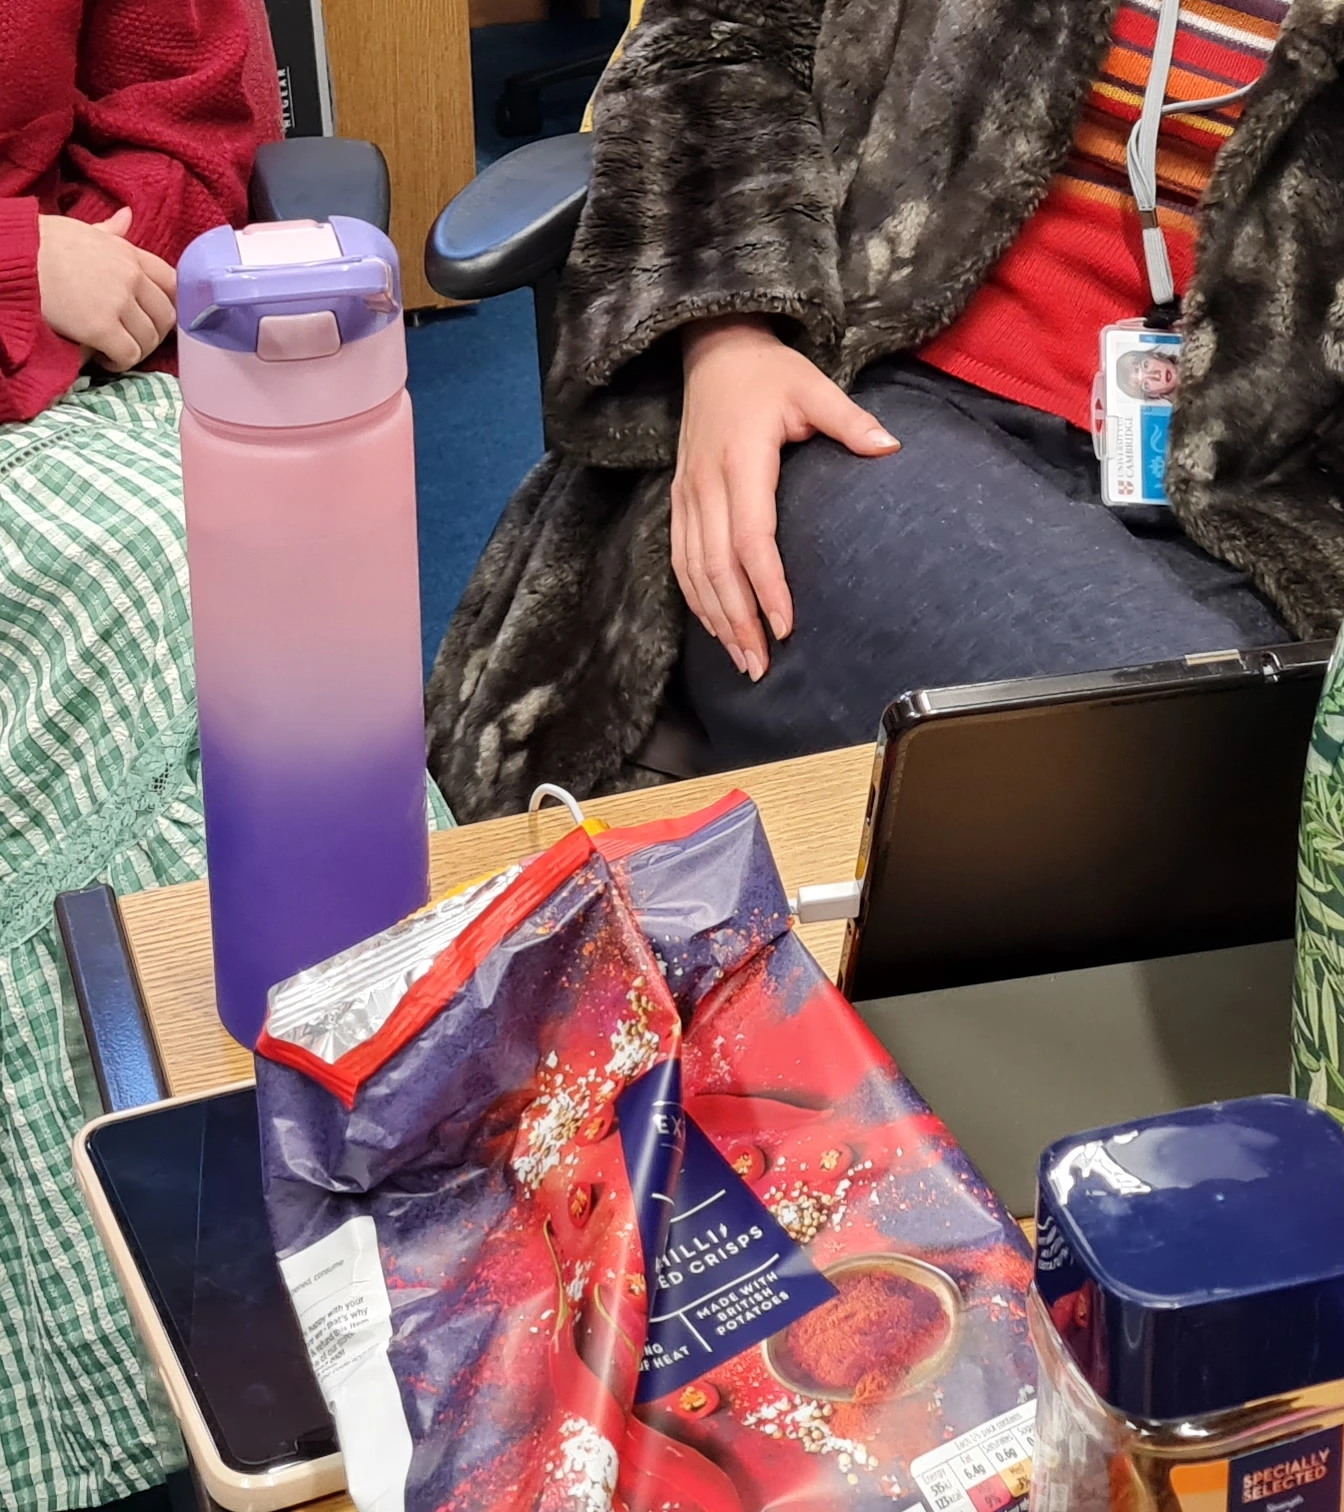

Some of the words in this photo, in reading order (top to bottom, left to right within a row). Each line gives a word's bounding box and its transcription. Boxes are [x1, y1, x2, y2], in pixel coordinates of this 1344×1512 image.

[1116, 428, 1124, 478] UNIVERSITY
[1124, 416, 1135, 478] CAMBRIDGE
[656, 1229, 720, 1274] HILLI
[690, 1226, 763, 1274] CRISPS
[328, 1304, 343, 1318] with
[344, 1297, 364, 1311] your
[351, 1307, 368, 1320] why
[697, 1288, 738, 1320] MADE
[739, 1271, 779, 1294] WITH
[716, 1291, 791, 1336] POTATOES
[717, 1286, 774, 1322] BRITISH
[653, 1346, 690, 1371] HEAT
[964, 1464, 986, 1479] 6.4g
[995, 1448, 1018, 1462] 0.6g
[1242, 1465, 1327, 1504] SELECTED
[1243, 1447, 1330, 1489] SPECIALLY
